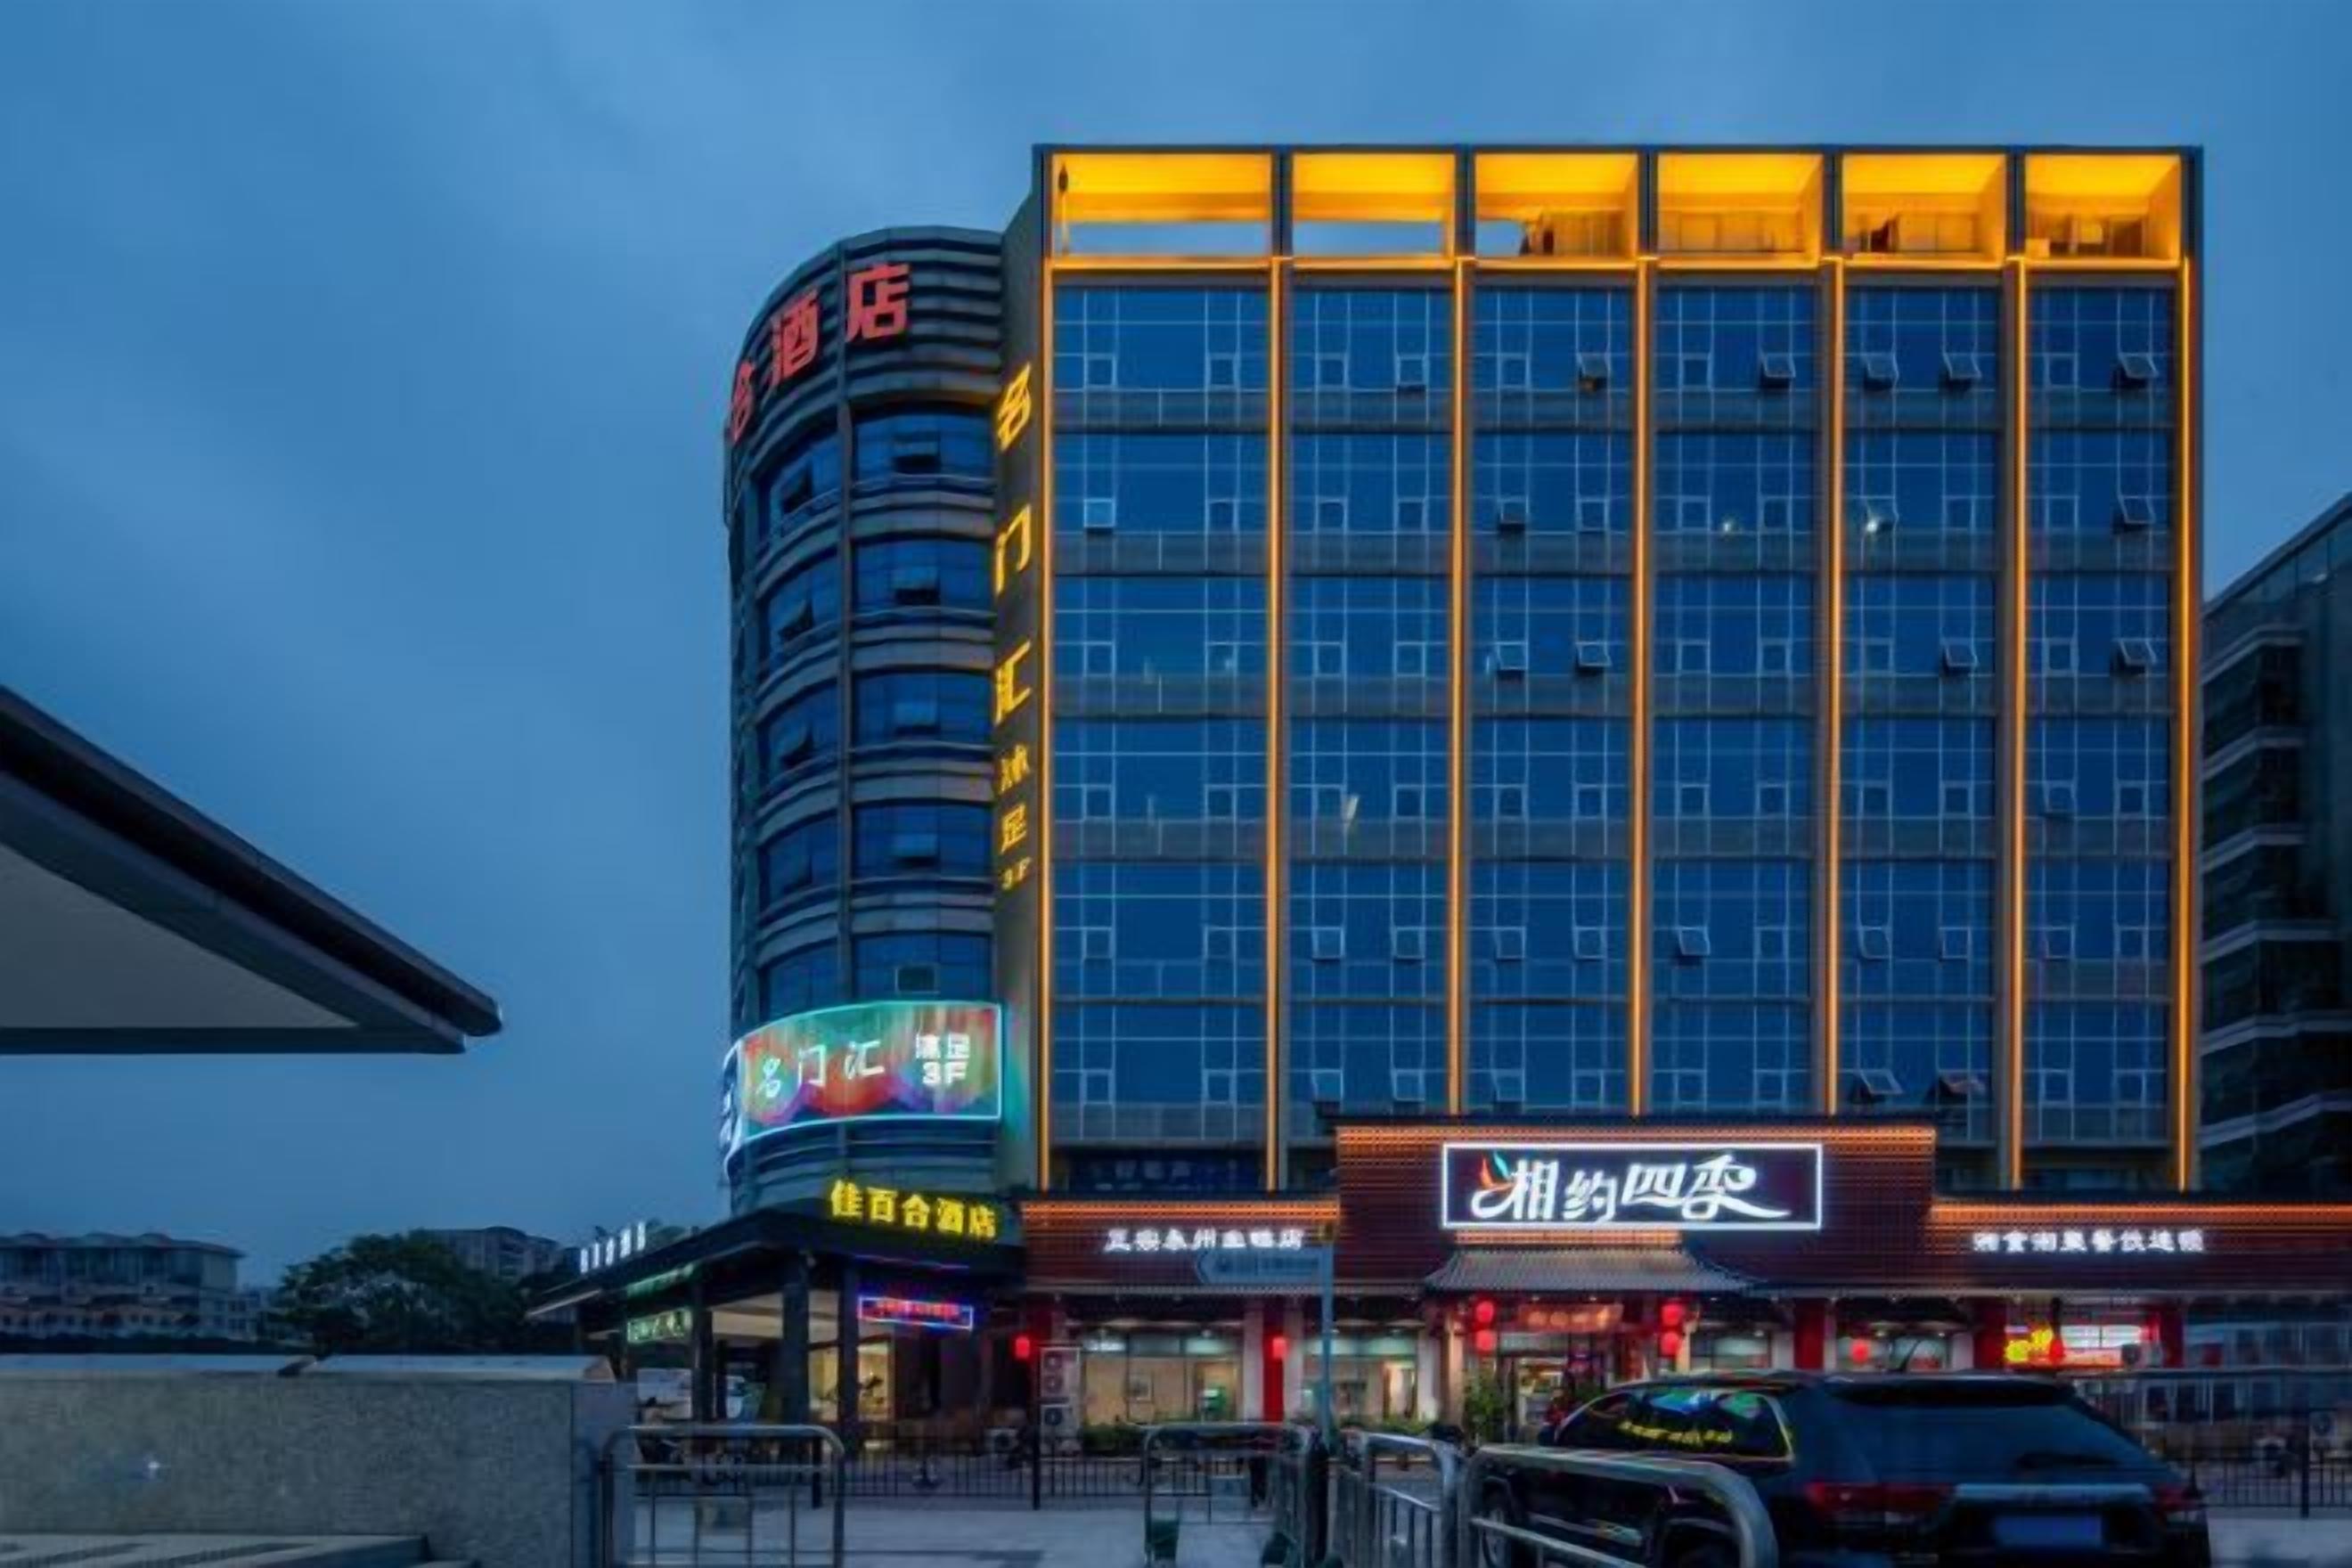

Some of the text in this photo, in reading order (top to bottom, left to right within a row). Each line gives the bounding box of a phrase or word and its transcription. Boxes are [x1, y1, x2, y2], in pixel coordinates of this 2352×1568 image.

[830, 1180, 996, 1239] 佳百合酒店
[1470, 1150, 1792, 1224] 湘约四季
